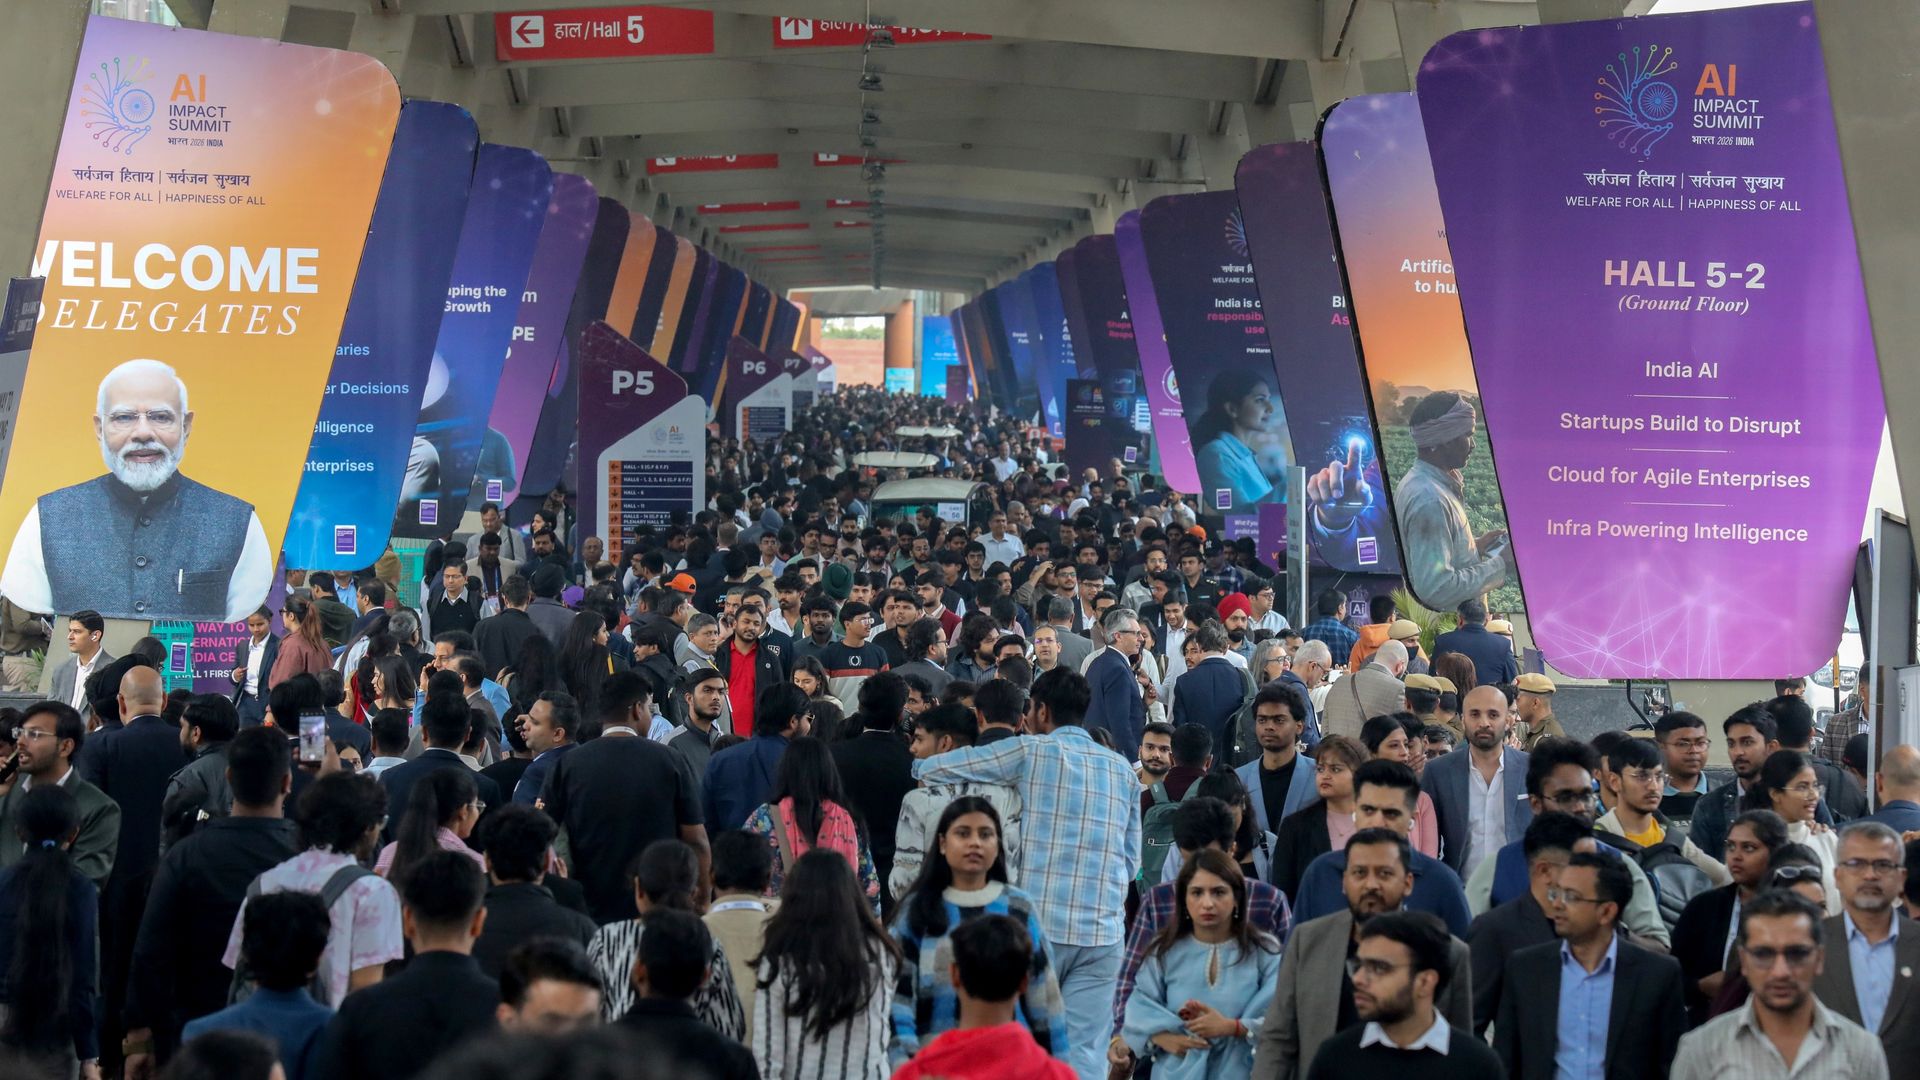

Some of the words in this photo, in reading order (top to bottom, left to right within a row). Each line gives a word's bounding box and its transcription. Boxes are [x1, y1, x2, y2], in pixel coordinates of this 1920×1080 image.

[554, 22, 582, 40] हाल
[592, 21, 620, 38] Hall
[626, 15, 645, 44] 5
[170, 73, 207, 102] AI
[1695, 63, 1737, 97] AI
[169, 104, 228, 119] IMPACT
[1693, 98, 1760, 114] IMPACT
[168, 118, 232, 133] SUMMIT
[1692, 114, 1765, 130] SUMMIT
[168, 137, 189, 147] भारत
[190, 138, 205, 147] 2026
[206, 139, 224, 148] INDIA
[1691, 135, 1716, 146] भारत
[1716, 136, 1735, 147] 2026
[1735, 137, 1755, 147] INDIA
[72, 165, 114, 182] सर्वजन
[119, 166, 155, 184] हिताय
[165, 168, 209, 185] सर्वजन
[212, 173, 252, 190] सुखाय
[1583, 168, 1632, 187] सर्वजन
[1637, 169, 1677, 188] हिताय
[1688, 170, 1738, 189] सर्वजन
[1742, 176, 1786, 194] सुखाय
[56, 189, 107, 200] WELFARE
[109, 191, 131, 201] FOR
[134, 192, 154, 202] ALL
[165, 193, 226, 204] HAPPINESS
[228, 195, 244, 205] OF
[246, 196, 267, 206] ALL
[1565, 196, 1622, 208] WELFARE
[1625, 197, 1650, 208] FOR
[1652, 198, 1675, 209] ALL
[1688, 198, 1757, 210] HAPPINESS
[1759, 200, 1776, 211] OF
[1779, 201, 1802, 212] ALL
[1400, 258, 1455, 274] Artific
[1212, 276, 1241, 284] WELFARE
[1241, 276, 1255, 284] FOR
[1604, 259, 1696, 289] HALL
[1705, 261, 1767, 290] 5-2
[484, 285, 507, 298] the
[1414, 279, 1432, 294] to
[1435, 279, 1459, 295] hu
[1214, 298, 1241, 309] India
[1243, 298, 1253, 309] is
[1618, 294, 1692, 313] (Ground
[1695, 296, 1750, 316] Floor)
[36, 298, 302, 336] ELEGATES
[1207, 311, 1264, 323] responsib
[335, 343, 371, 357] aries
[742, 360, 767, 375] P6
[1645, 361, 1693, 379] India
[1698, 362, 1719, 380] AI
[340, 381, 410, 395] Decisions
[612, 369, 655, 397] P5
[1560, 412, 1645, 434] Startups
[1650, 414, 1699, 433] Build
[1703, 416, 1724, 433] to
[1729, 415, 1801, 438] Disrupt
[1548, 465, 1605, 484] Cloud
[1610, 466, 1638, 484] for
[1643, 467, 1692, 489] Agile
[1698, 469, 1811, 491] Enterprises
[1547, 518, 1592, 537] Infra
[1597, 520, 1689, 543] Powering
[1694, 522, 1809, 545] Intelligence
[196, 623, 224, 632] WAY
